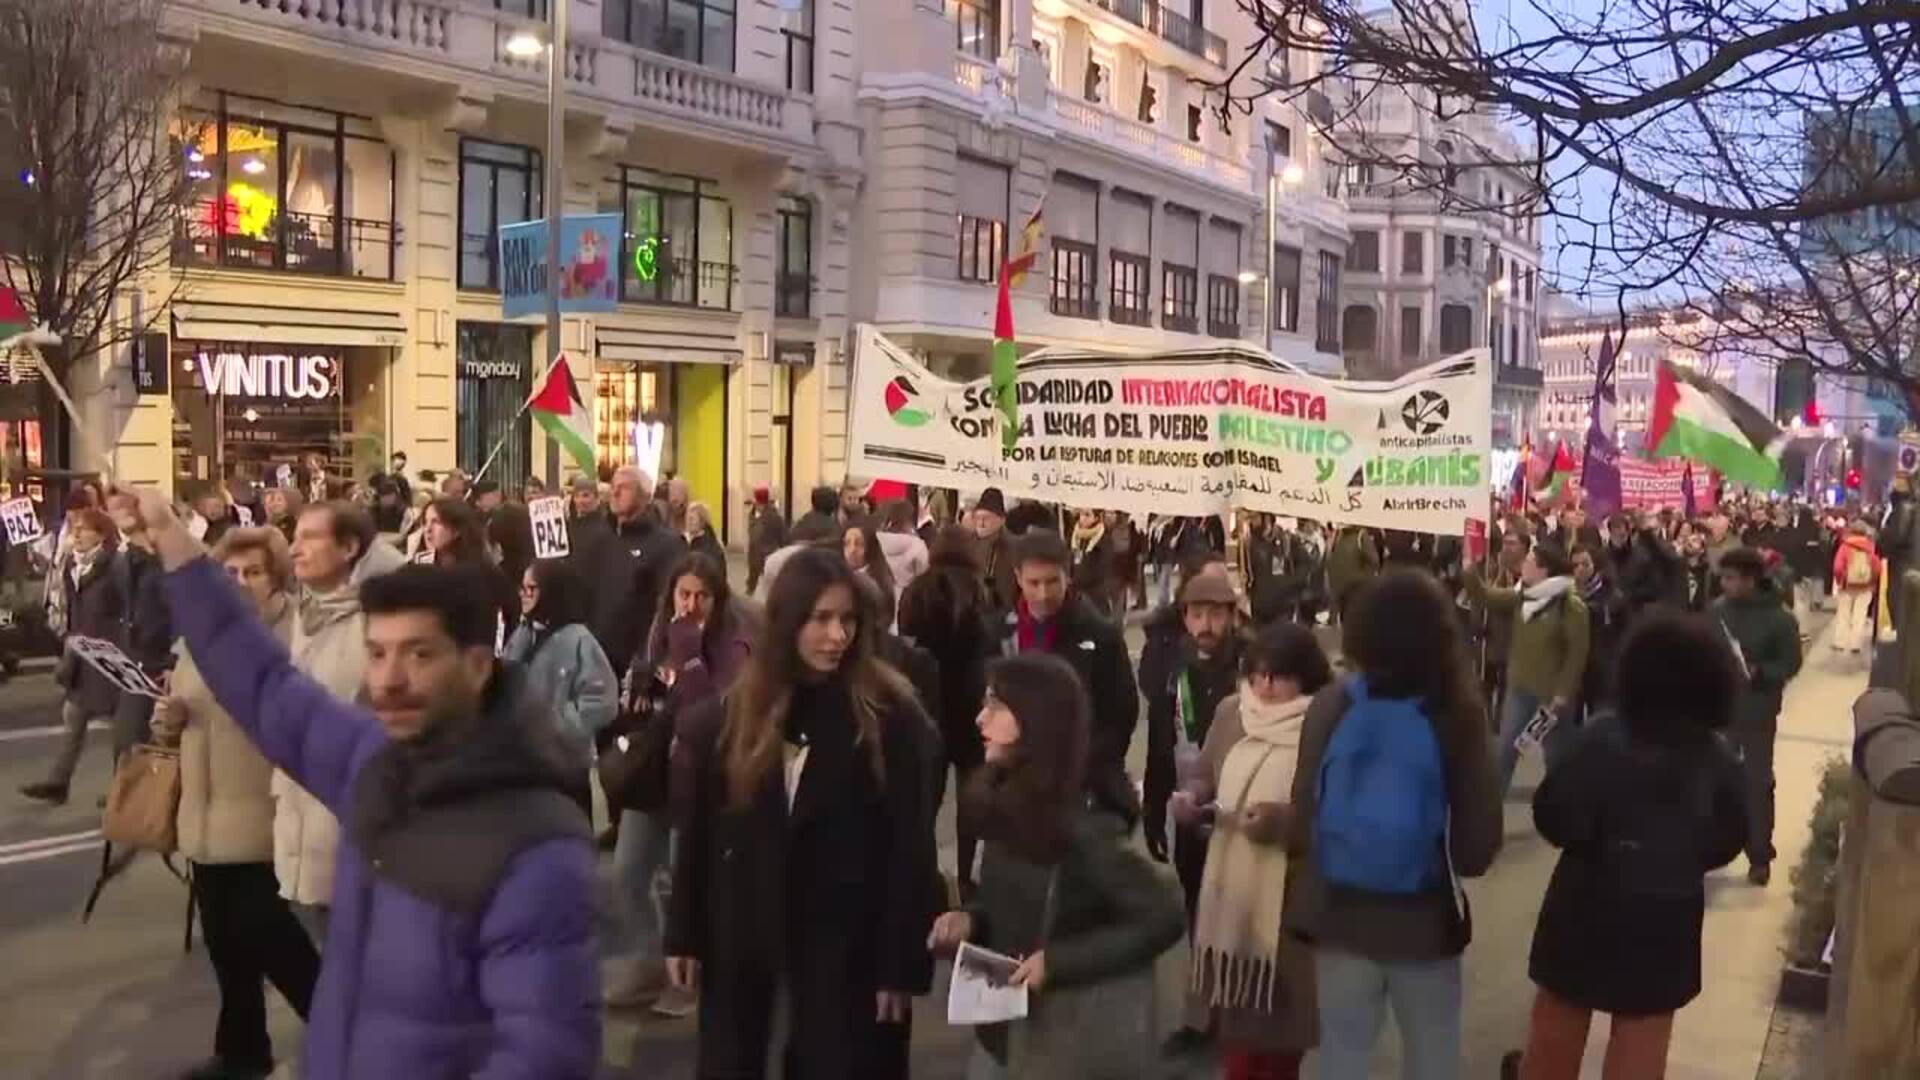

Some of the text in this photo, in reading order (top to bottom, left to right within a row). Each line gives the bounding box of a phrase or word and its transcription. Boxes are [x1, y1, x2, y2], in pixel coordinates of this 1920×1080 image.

[199, 352, 330, 399] VINITUS
[466, 360, 520, 380] monday
[963, 379, 1113, 412] SOIDARIDAD
[1044, 411, 1097, 438] LUCHA
[1104, 412, 1142, 438] DEL
[1149, 413, 1208, 442] PUEBLO
[1218, 413, 1353, 455] PALESTINO
[1380, 434, 1472, 449] anticapitalistas
[1002, 447, 1035, 462] POR
[1041, 445, 1056, 461] LA
[1116, 448, 1134, 464] DE
[1203, 449, 1235, 468] CON
[1237, 449, 1282, 473] ISRAEL
[1383, 497, 1466, 511] AbrirBrecha
[7, 512, 39, 541] PAZ
[536, 518, 567, 555] PAZ
